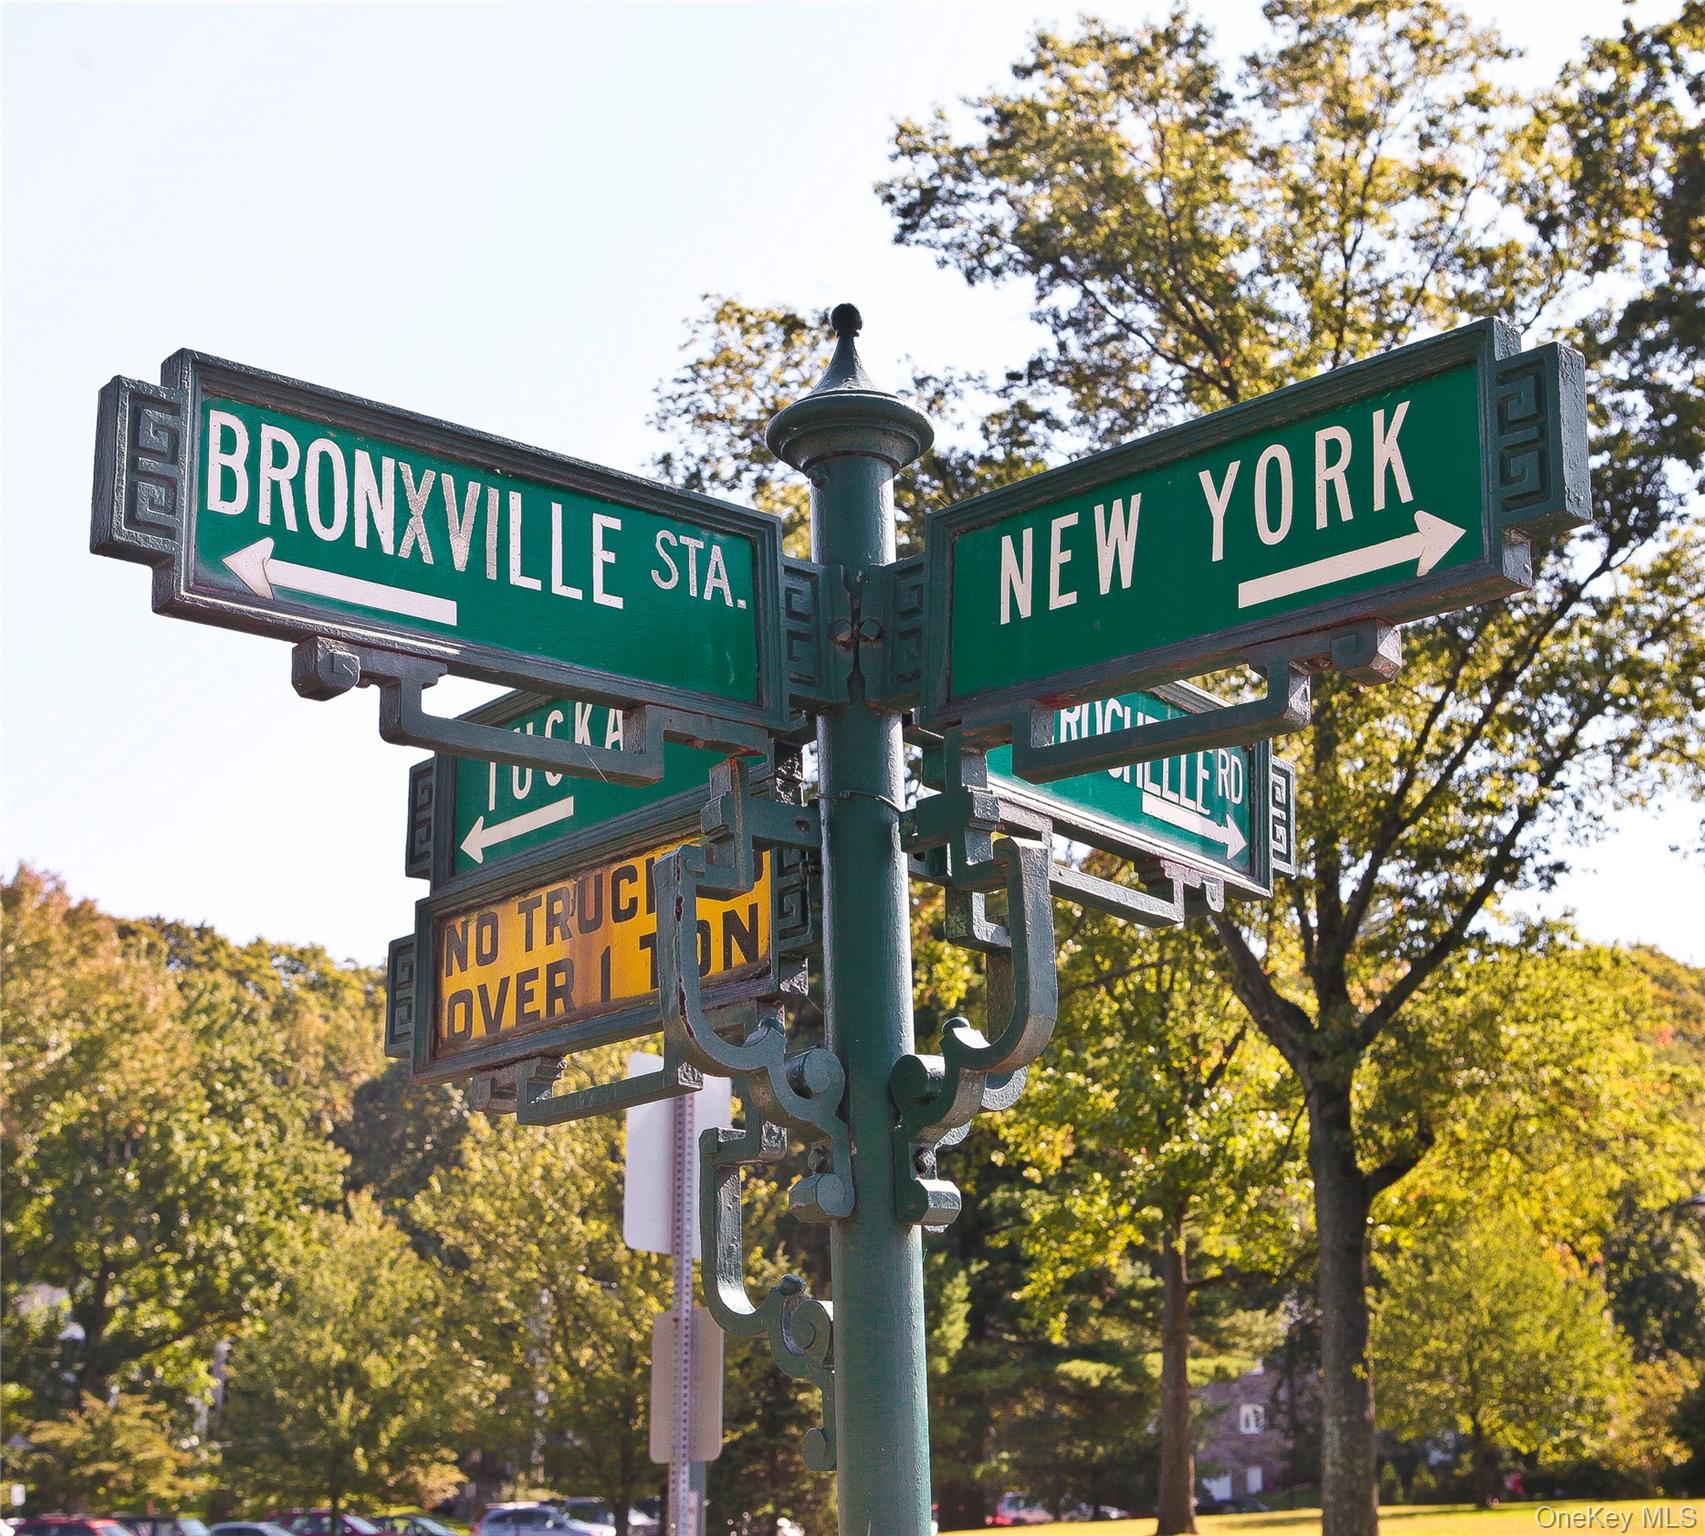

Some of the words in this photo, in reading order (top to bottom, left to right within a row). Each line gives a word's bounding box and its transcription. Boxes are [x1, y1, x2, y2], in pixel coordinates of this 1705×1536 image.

[207, 409, 624, 609] BRONXVILLE
[651, 529, 746, 609] STA.
[1000, 492, 1142, 625] NEW
[1198, 400, 1413, 562] YORK
[1218, 748, 1243, 805] RD
[445, 911, 499, 978] NO
[447, 957, 577, 1042] OVER
[601, 945, 611, 1003] 1
